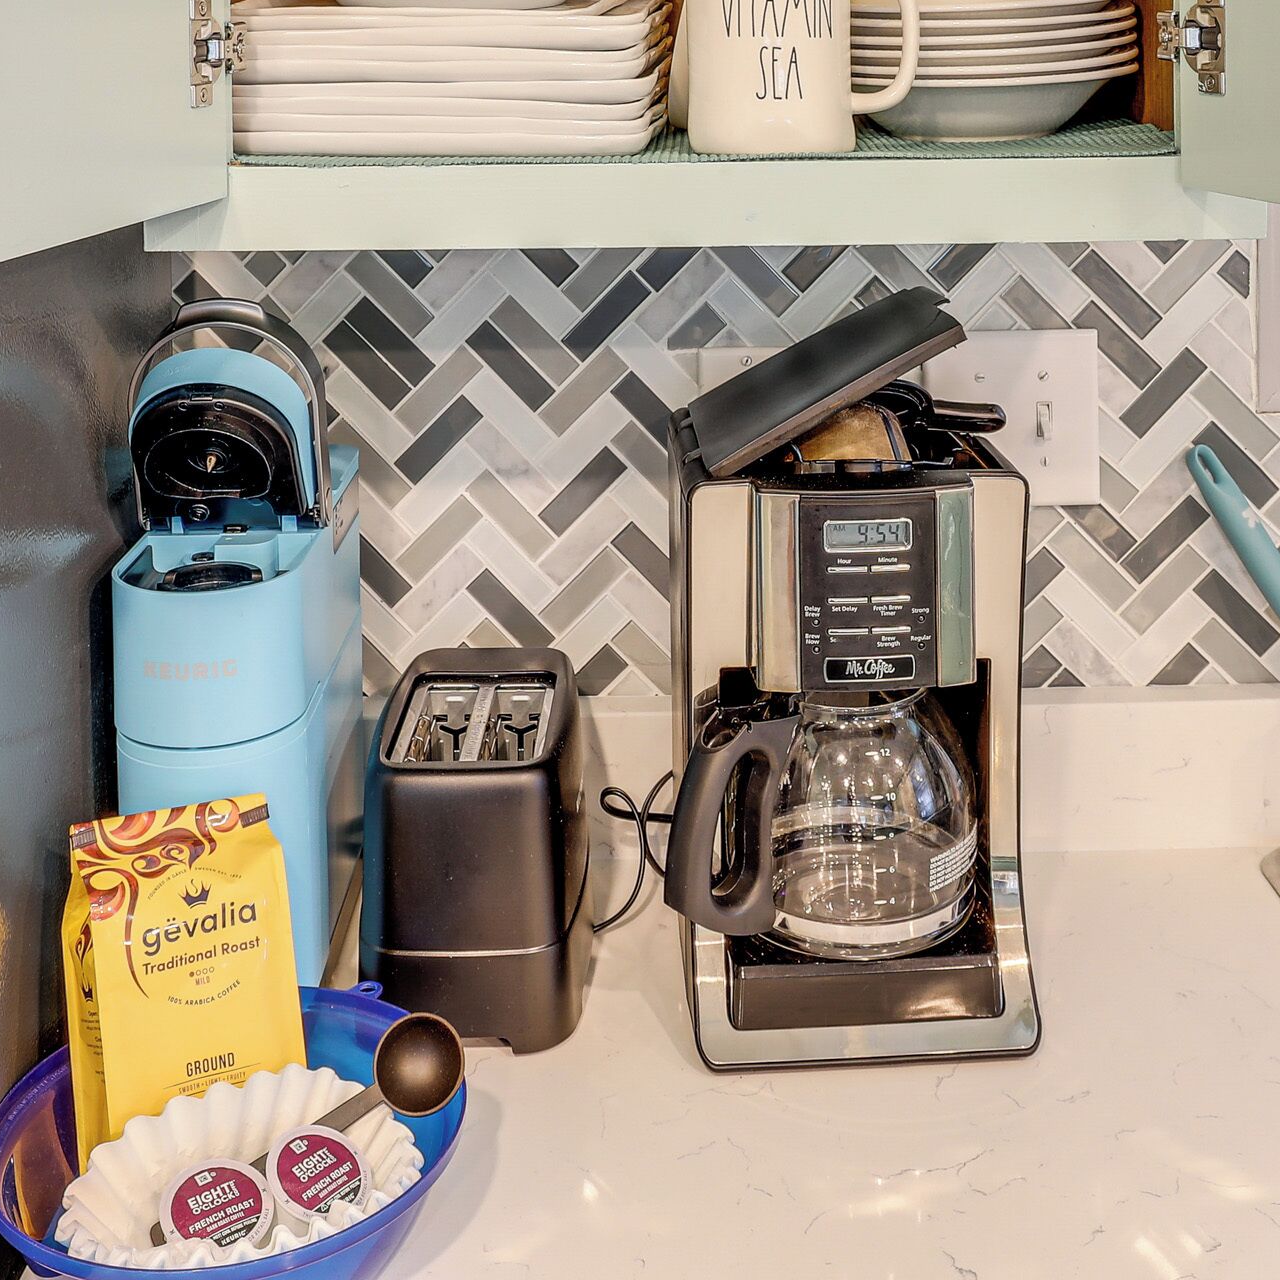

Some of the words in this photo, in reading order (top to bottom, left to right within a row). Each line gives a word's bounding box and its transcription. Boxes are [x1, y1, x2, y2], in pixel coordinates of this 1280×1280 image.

[755, 46, 803, 101] SEA
[858, 523, 900, 544] 9:54
[804, 605, 821, 613] Delay
[842, 605, 858, 613] Delay
[910, 634, 932, 642] Regular
[144, 659, 238, 681] KEURIG
[845, 660, 864, 678] Mr.
[864, 659, 896, 680] Coffee
[880, 748, 891, 757] 12
[885, 792, 896, 801] 10
[889, 866, 895, 874] 6
[889, 897, 895, 905] 4
[142, 901, 257, 957] gëvalia
[142, 945, 217, 976] Traditional
[221, 935, 261, 956] Roast
[195, 975, 211, 986] MILD
[167, 995, 182, 1005] 100%
[185, 996, 216, 1006] ARABICA
[217, 979, 241, 999] COFFEE
[186, 1052, 235, 1077] GROUND
[178, 1082, 201, 1095] SMOOTH
[291, 1148, 326, 1178] EIGHT
[300, 1157, 334, 1183] O'CLOCK
[302, 1175, 332, 1202] FRENCH
[330, 1161, 354, 1181] ROAST
[187, 1181, 232, 1210] EIGHT
[192, 1192, 235, 1215] O'CLOCK
[188, 1210, 225, 1235] FRENCH
[225, 1198, 255, 1216] ROAST
[221, 1229, 248, 1246] KEURIG
